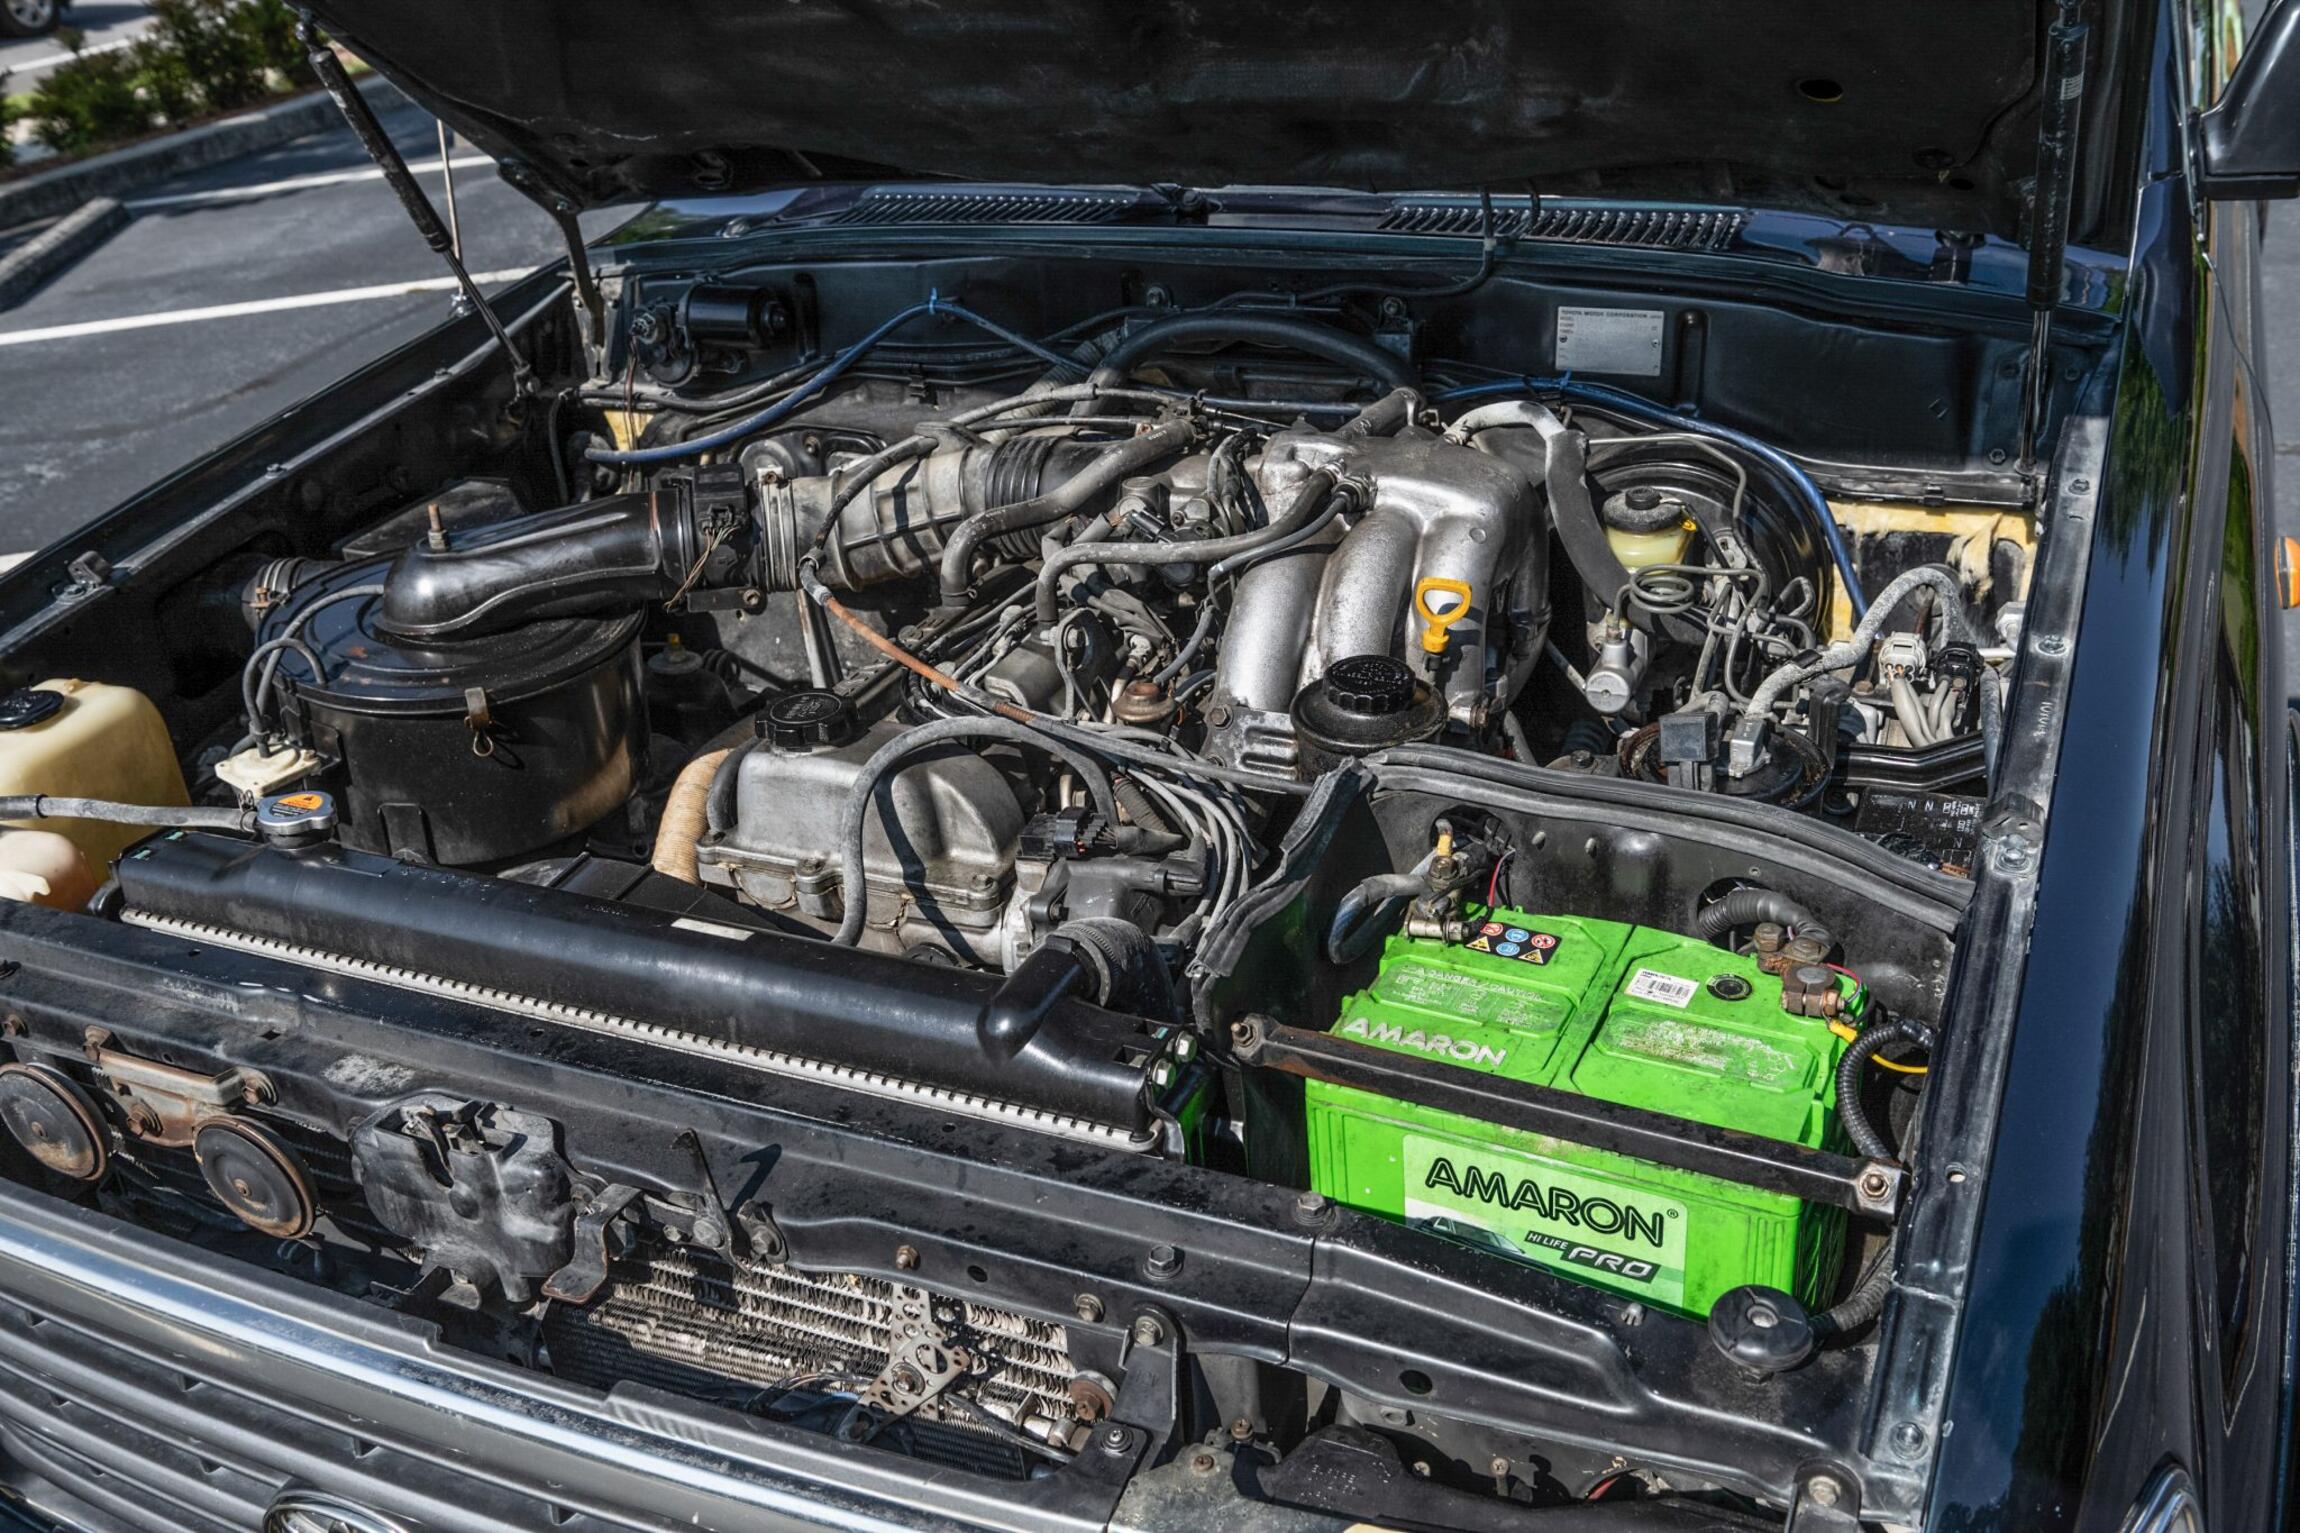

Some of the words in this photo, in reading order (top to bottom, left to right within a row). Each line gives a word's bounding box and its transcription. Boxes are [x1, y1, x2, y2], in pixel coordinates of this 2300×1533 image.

[1342, 1017, 1507, 1066] AMARON
[1425, 1157, 1664, 1248] AMARON
[1528, 1232, 1542, 1242] HI
[1542, 1237, 1569, 1250] LIFE
[1568, 1247, 1652, 1278] PRO
